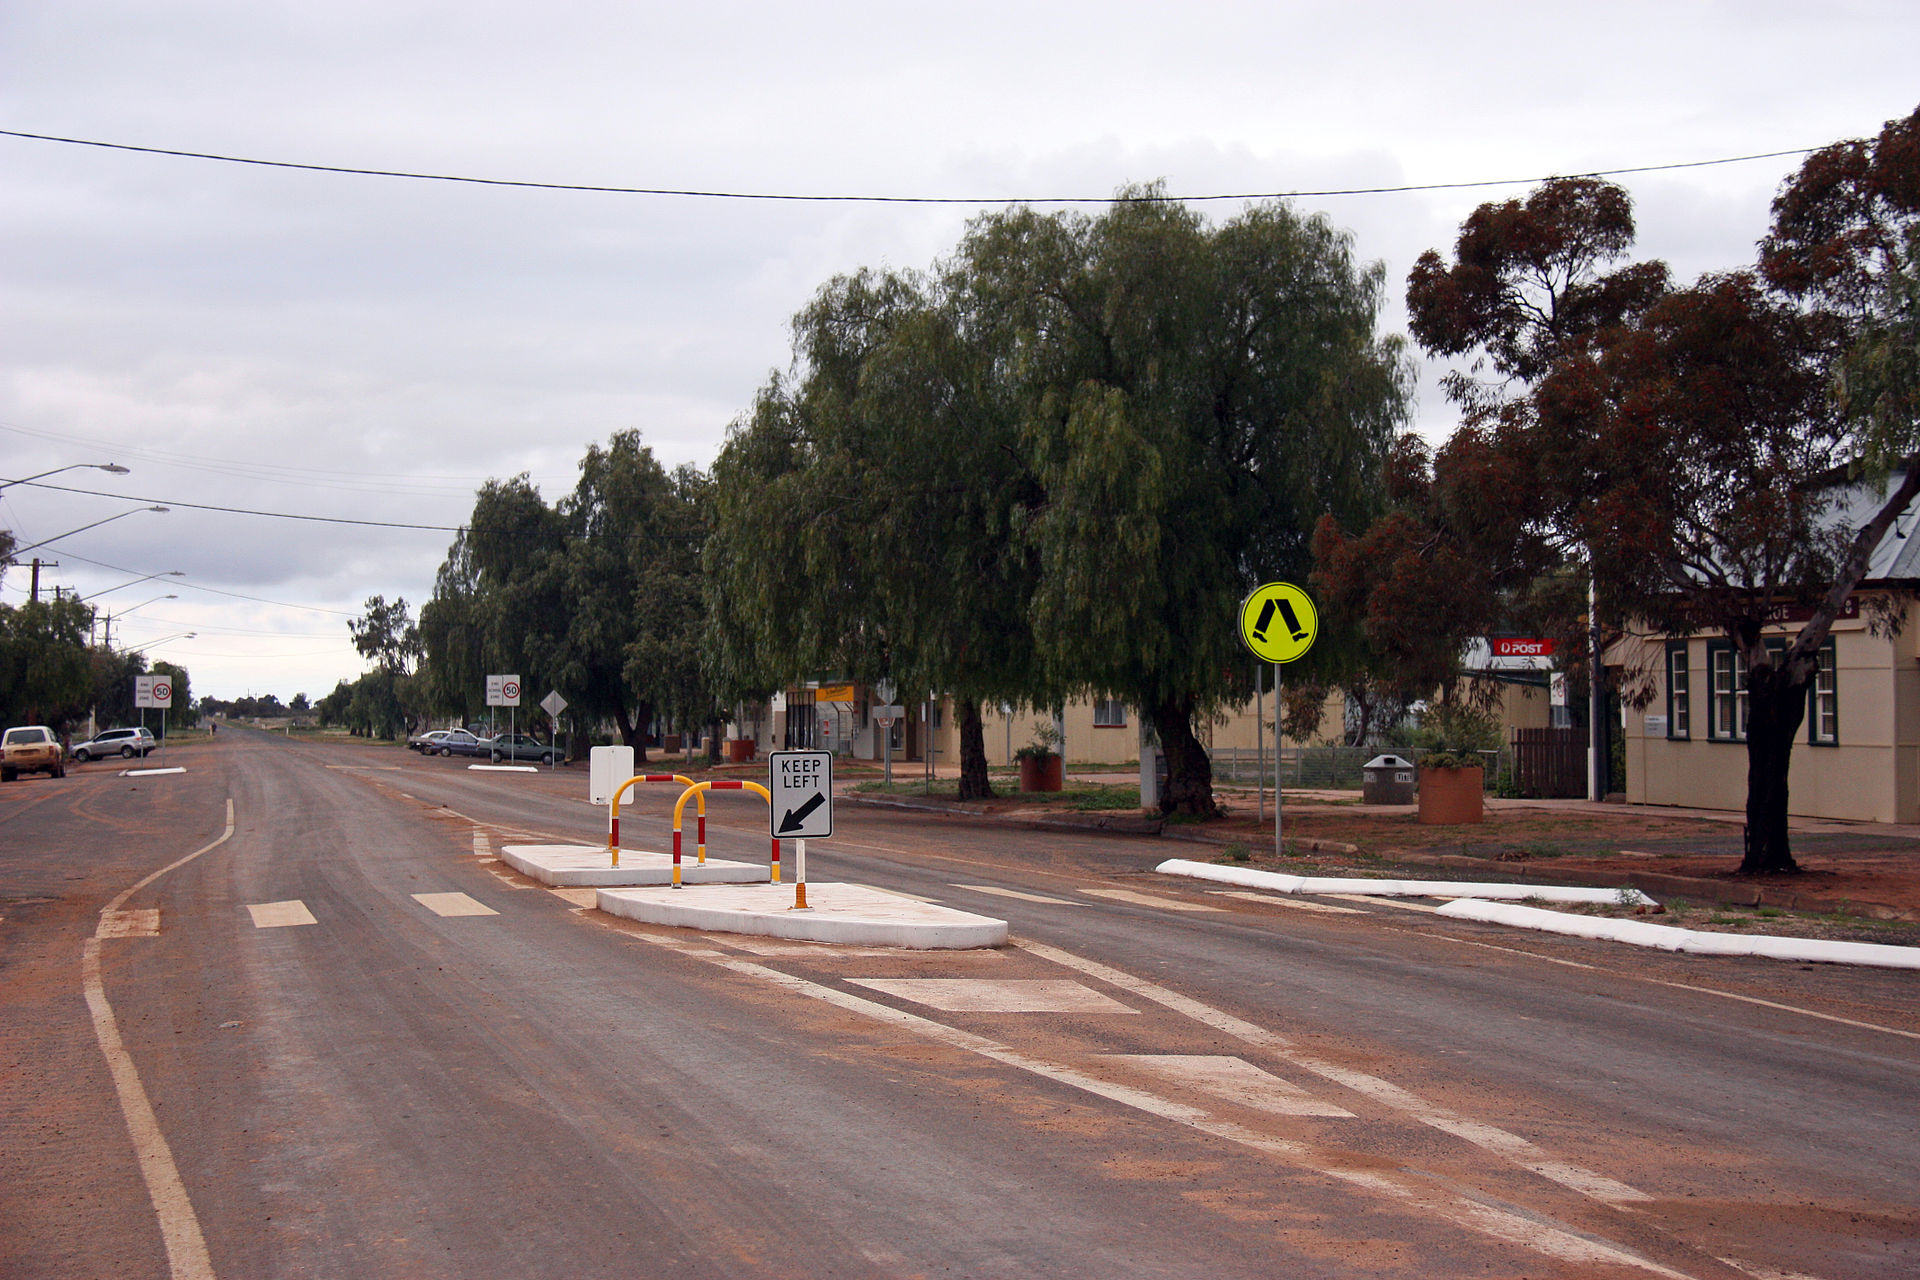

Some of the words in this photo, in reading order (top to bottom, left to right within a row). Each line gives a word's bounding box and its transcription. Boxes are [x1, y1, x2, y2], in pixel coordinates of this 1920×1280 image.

[1512, 644, 1544, 654] POST
[156, 687, 168, 696] 50
[506, 686, 517, 695] 50
[782, 760, 821, 773] KEEP
[783, 775, 820, 788] LEFT
